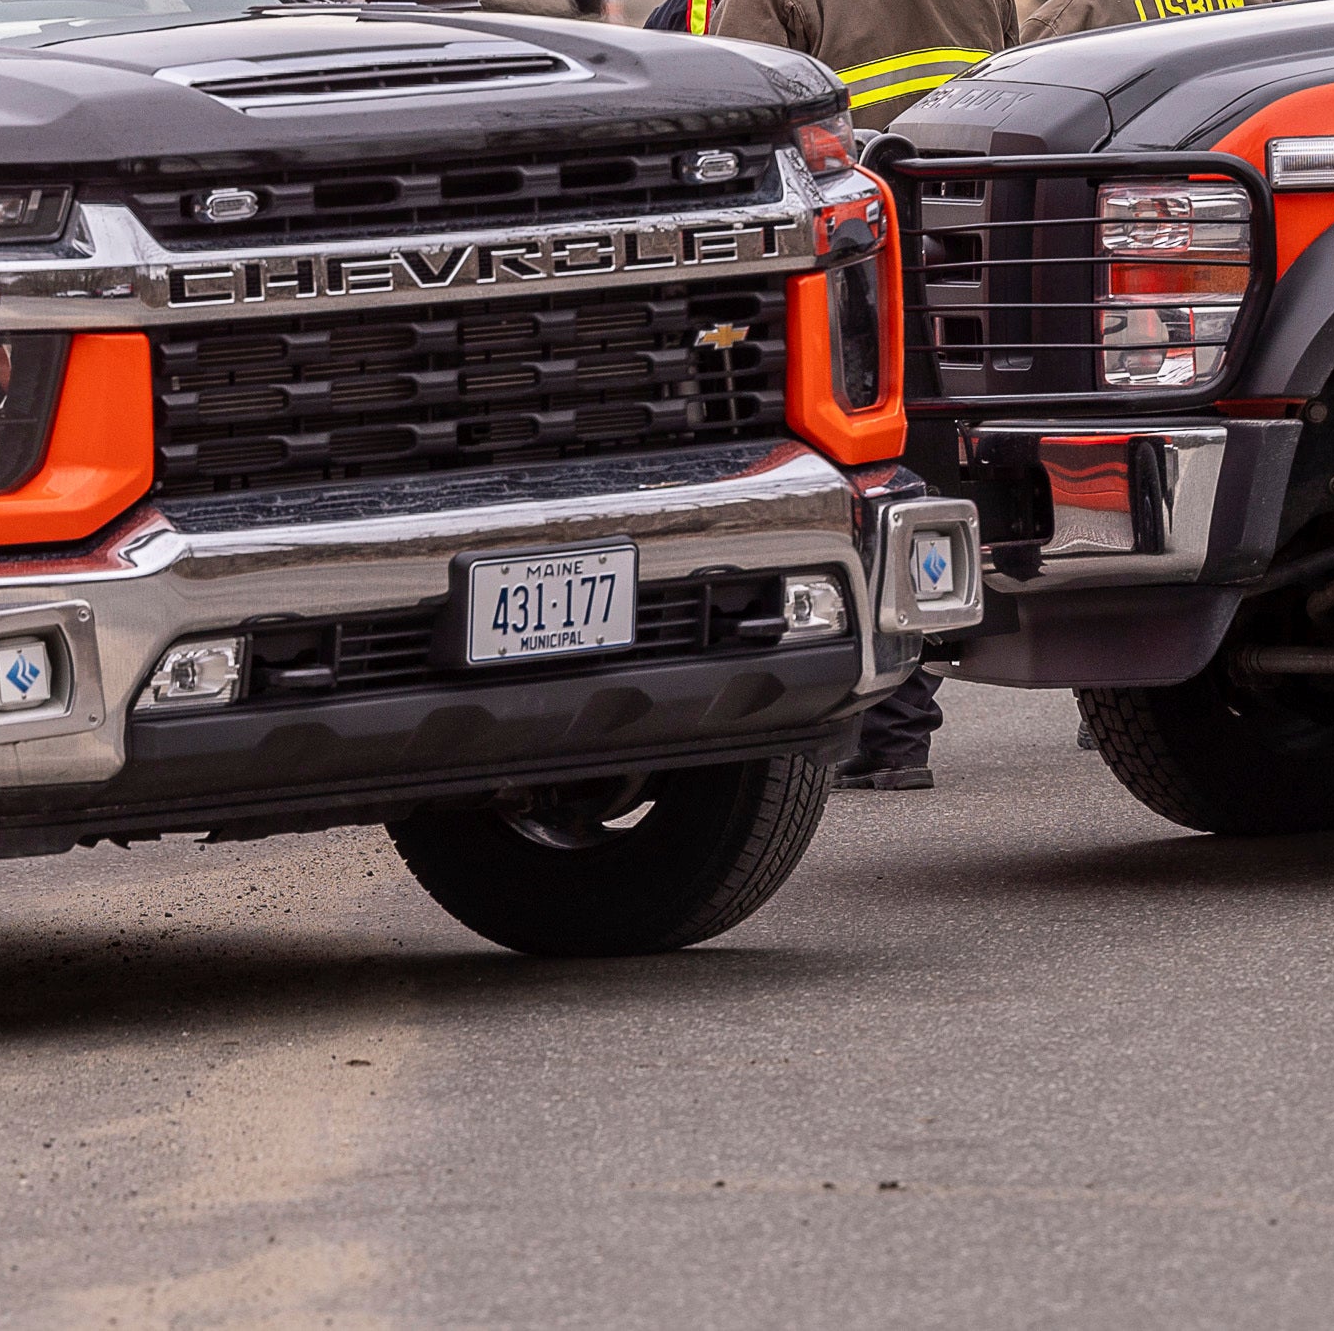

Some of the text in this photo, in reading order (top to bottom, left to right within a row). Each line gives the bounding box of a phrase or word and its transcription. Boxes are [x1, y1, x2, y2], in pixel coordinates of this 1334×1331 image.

[168, 223, 798, 308] CHEVROLET
[526, 560, 584, 580] MAINE
[520, 630, 585, 651] MUNICIPAL
